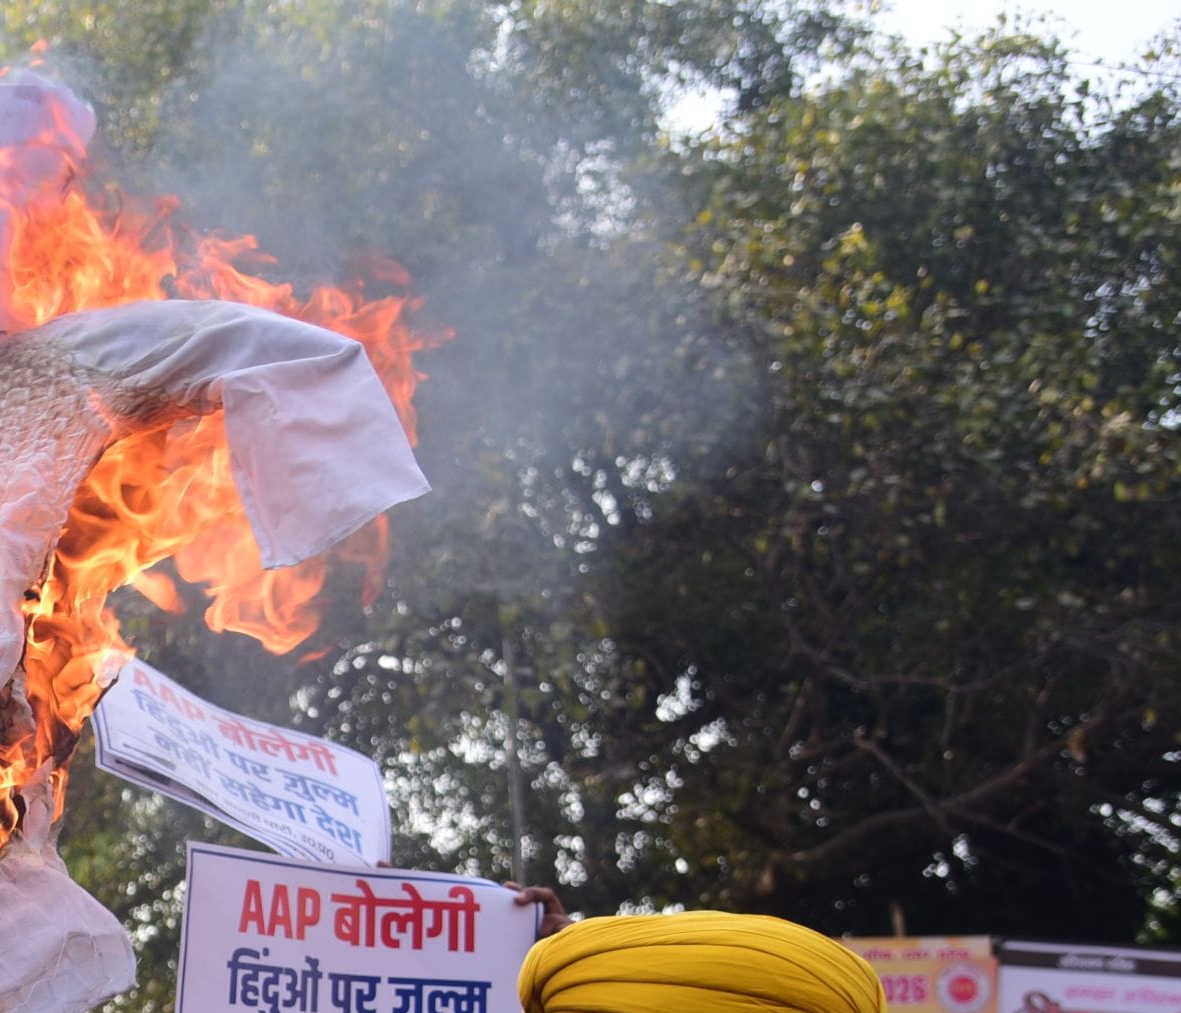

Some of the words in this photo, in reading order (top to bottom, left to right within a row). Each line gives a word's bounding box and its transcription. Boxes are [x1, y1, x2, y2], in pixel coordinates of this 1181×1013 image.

[133, 667, 205, 721] AAP
[210, 715, 338, 776] बोलेगी
[223, 748, 271, 782] पर
[214, 769, 306, 824] सहेगा
[311, 804, 362, 853] देश
[238, 879, 321, 941] AAP
[331, 879, 480, 952] बोलेगी
